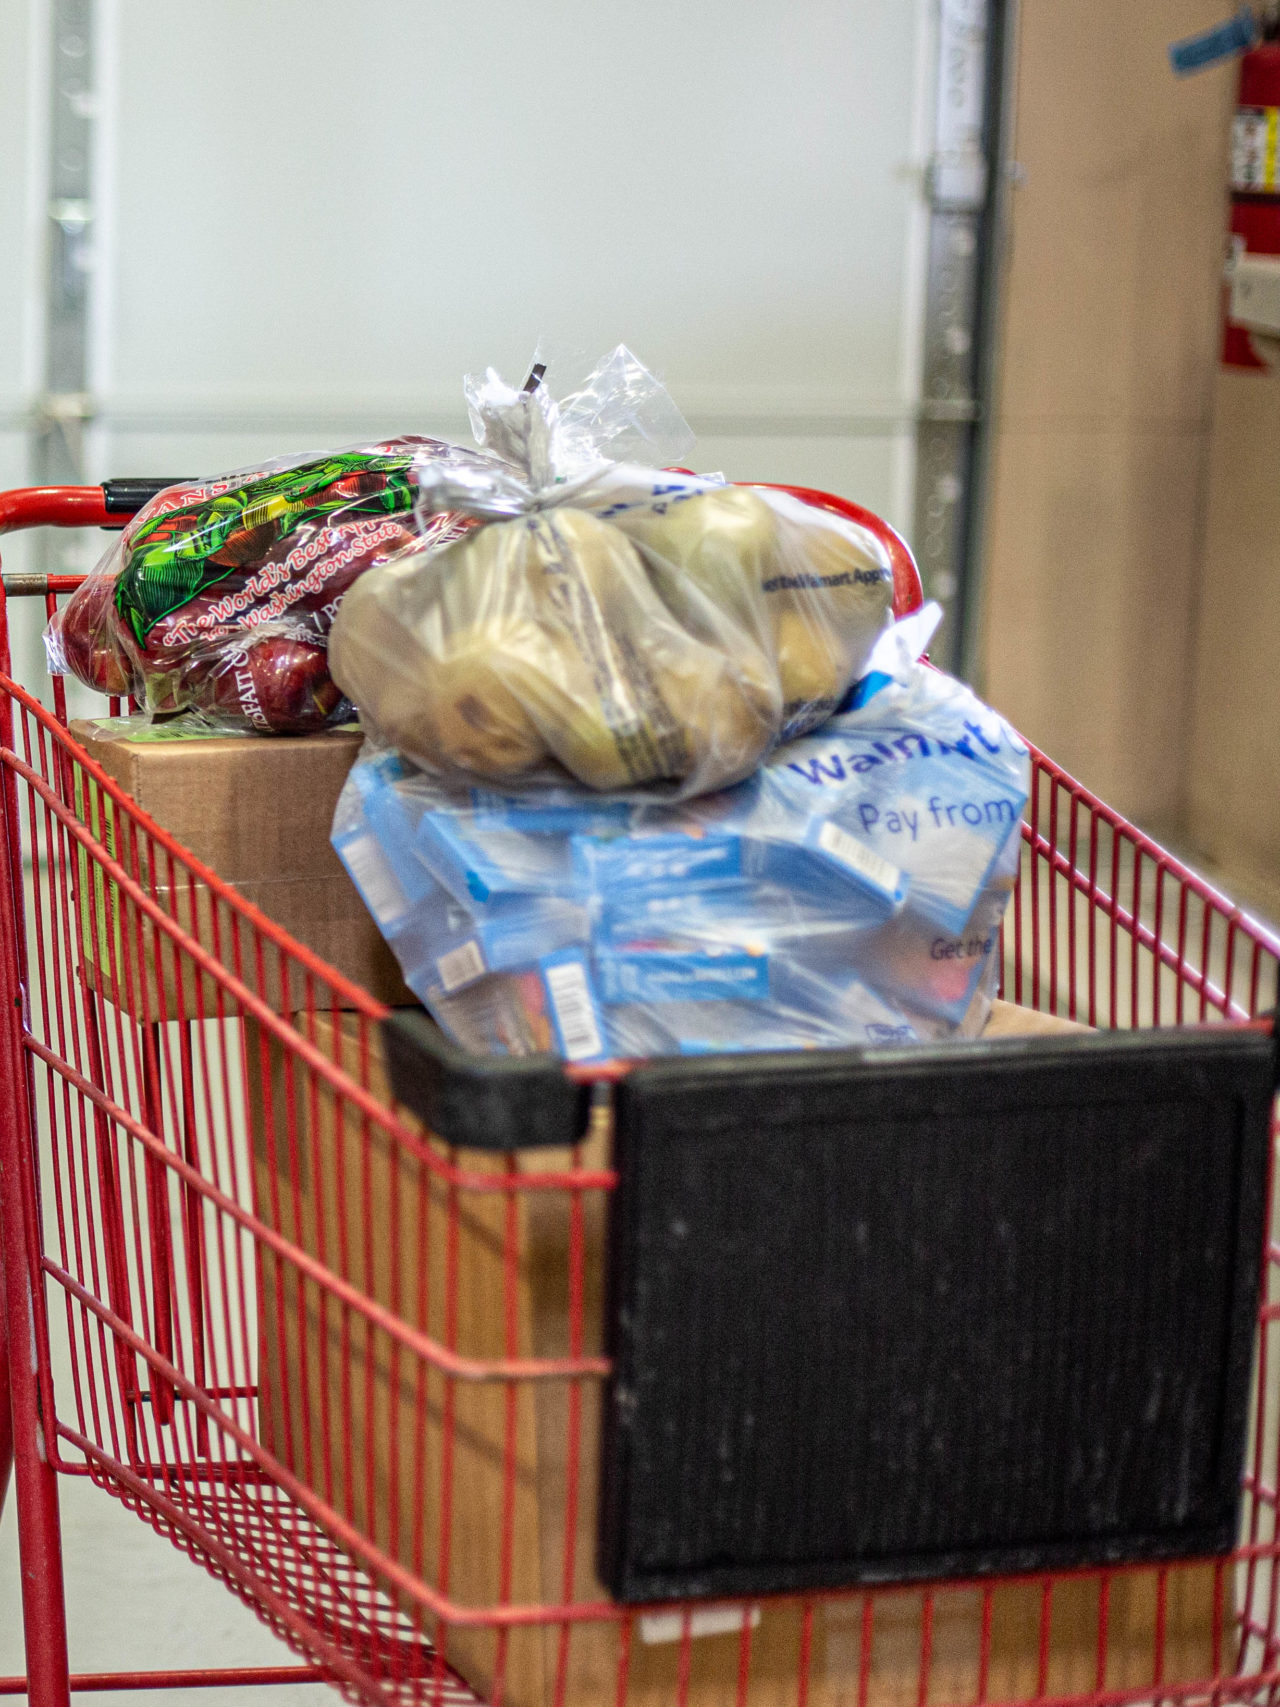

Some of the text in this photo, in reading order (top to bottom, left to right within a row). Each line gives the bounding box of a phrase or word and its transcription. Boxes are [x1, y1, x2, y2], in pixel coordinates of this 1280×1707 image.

[287, 526, 335, 574] Best
[237, 547, 354, 631] Washington
[351, 522, 404, 558] State
[787, 719, 1001, 786] Walmt
[858, 796, 1018, 842] Pay from
[929, 936, 964, 961] Get
